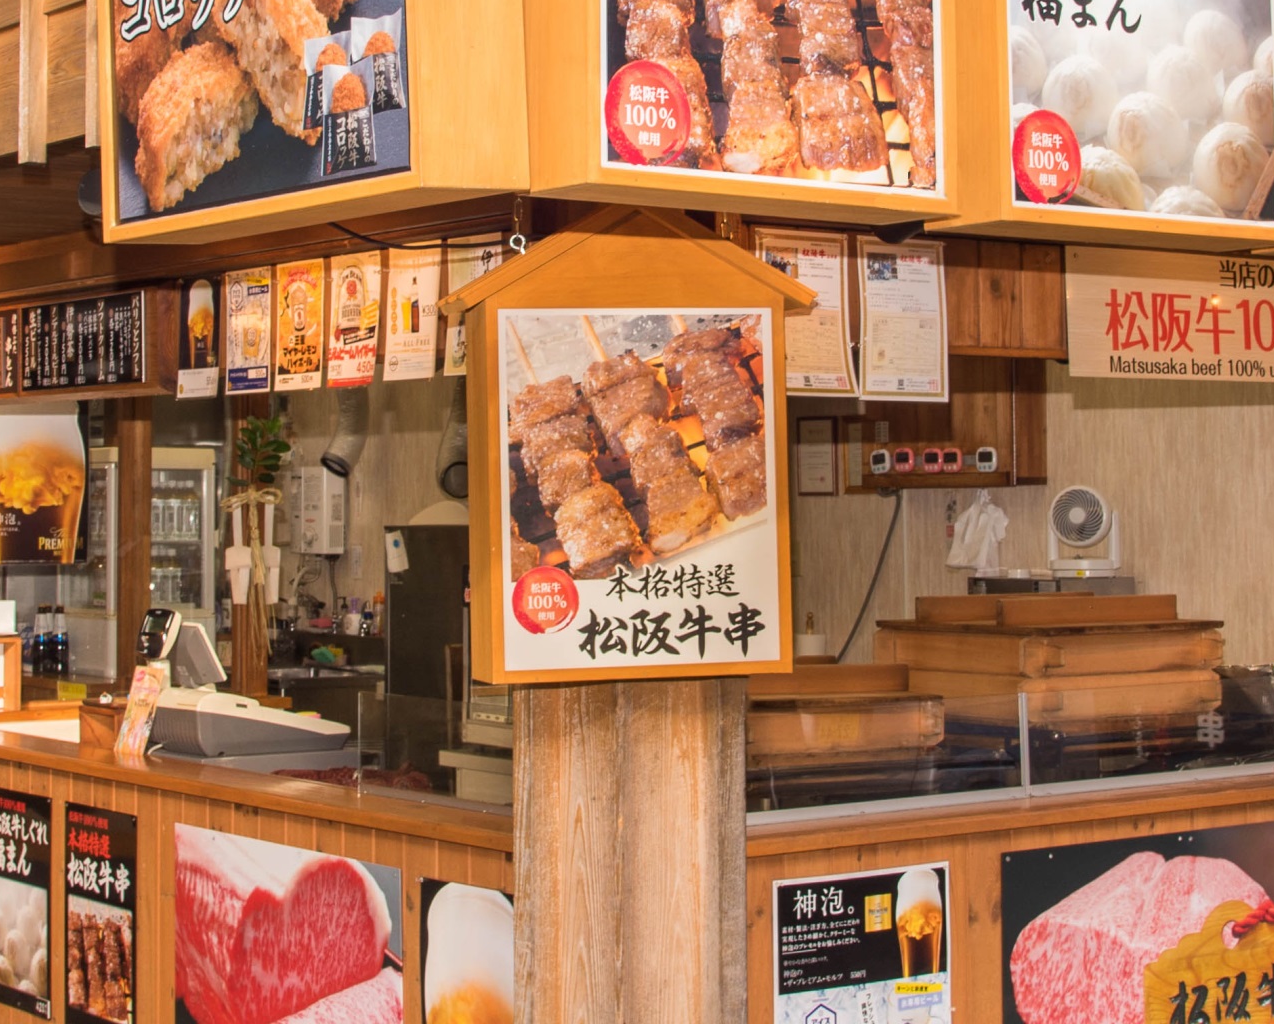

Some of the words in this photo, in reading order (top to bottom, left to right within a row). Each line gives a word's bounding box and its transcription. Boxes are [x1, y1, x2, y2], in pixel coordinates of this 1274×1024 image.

[374, 56, 388, 109] 松阪牛
[629, 82, 670, 105] 松阪牛
[624, 102, 677, 130] 100%
[336, 118, 348, 169] コロッケ
[347, 115, 360, 166] 松阪牛
[638, 129, 662, 147] 使用
[1031, 132, 1063, 148] 松阪牛
[1026, 149, 1070, 173] 100%
[1038, 173, 1058, 187] 使用
[282, 347, 317, 358] マイヤーレモン
[287, 358, 312, 369] ハイボール
[1109, 355, 1187, 376] Matsusaka
[1191, 358, 1222, 377] beef
[1227, 359, 1265, 378] 100%
[531, 582, 562, 593] 松阪牛
[606, 564, 740, 602] 本格特選
[527, 594, 567, 609] 100%
[538, 611, 555, 621] 使用
[578, 603, 766, 660] 松阪牛串
[67, 827, 111, 858] 本格特選
[67, 852, 130, 903] 松阪牛串
[793, 886, 855, 920] 神泡。
